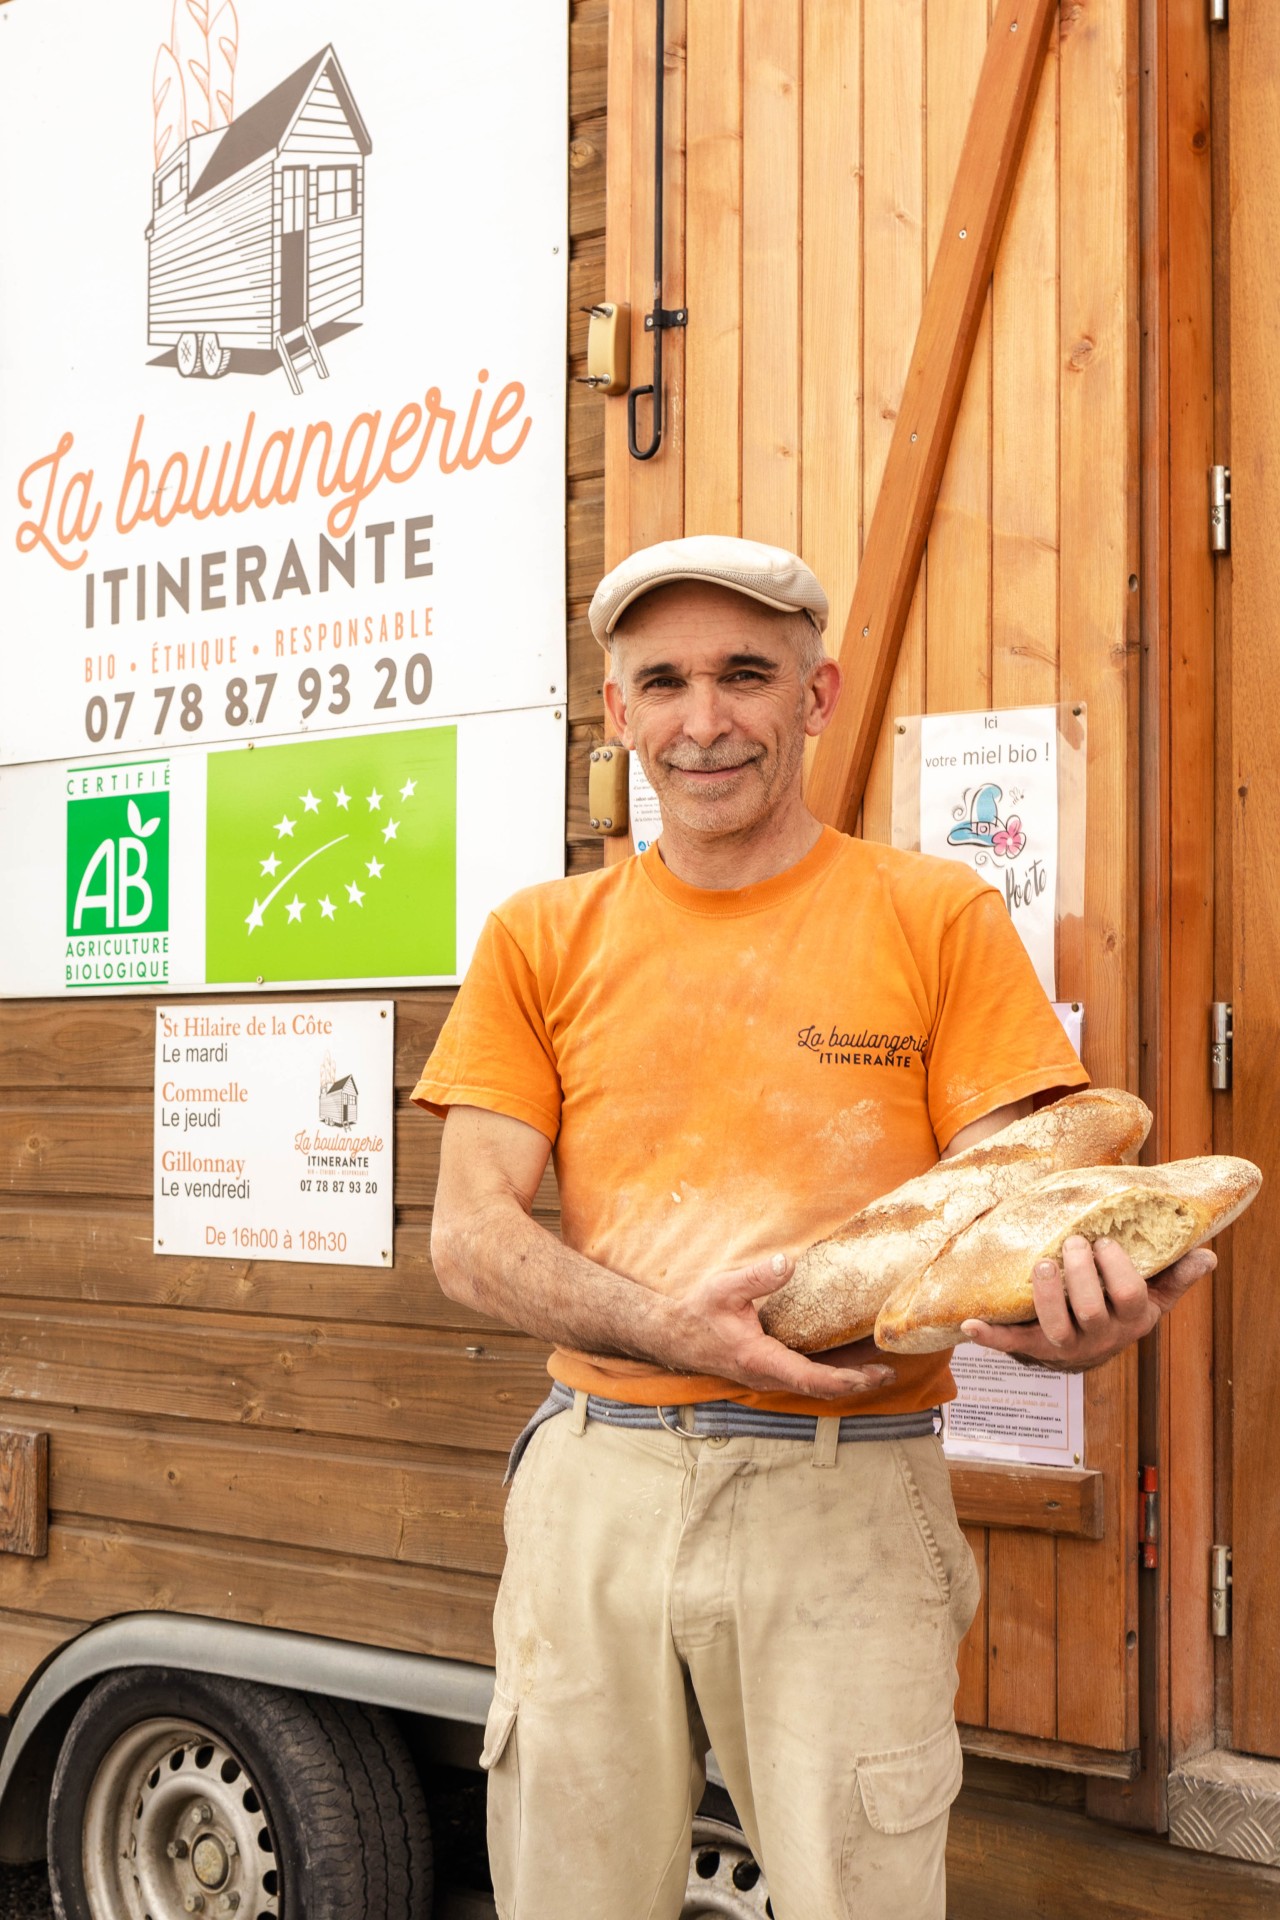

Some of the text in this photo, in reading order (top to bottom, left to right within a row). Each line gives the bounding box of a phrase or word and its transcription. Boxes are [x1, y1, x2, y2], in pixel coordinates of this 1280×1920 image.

[16, 368, 532, 570] La boulangerie
[85, 514, 434, 629] ITINERANTE
[84, 606, 434, 683] BIO ÉTHIQUE RESPONSABLE
[84, 652, 433, 742] 07 78 87 93 20
[984, 716, 998, 730] Ici
[925, 754, 957, 768] votre
[962, 745, 1001, 766] miel
[1008, 744, 1037, 763] bio
[67, 764, 170, 795] CERTIFIÉ
[73, 836, 152, 930] AB
[66, 937, 168, 958] AGRICULTURE
[66, 961, 168, 980] BIOLOGIQUE
[163, 1014, 332, 1037] St Hilaire de la Côte
[162, 1043, 228, 1062] Le mardi
[798, 1025, 928, 1056] La boulangerie
[820, 1052, 911, 1068] ITINERANTE
[162, 1082, 248, 1102] Commelle
[162, 1108, 220, 1132] Le jeudi
[294, 1129, 384, 1158] La boulangerie
[162, 1150, 246, 1180] Gillonnay
[308, 1156, 369, 1168] ITINERANTE
[161, 1177, 250, 1199] Le vendredi
[300, 1180, 378, 1194] 07 78 87 93 20
[206, 1226, 347, 1252] De 16h00 à 18h30
